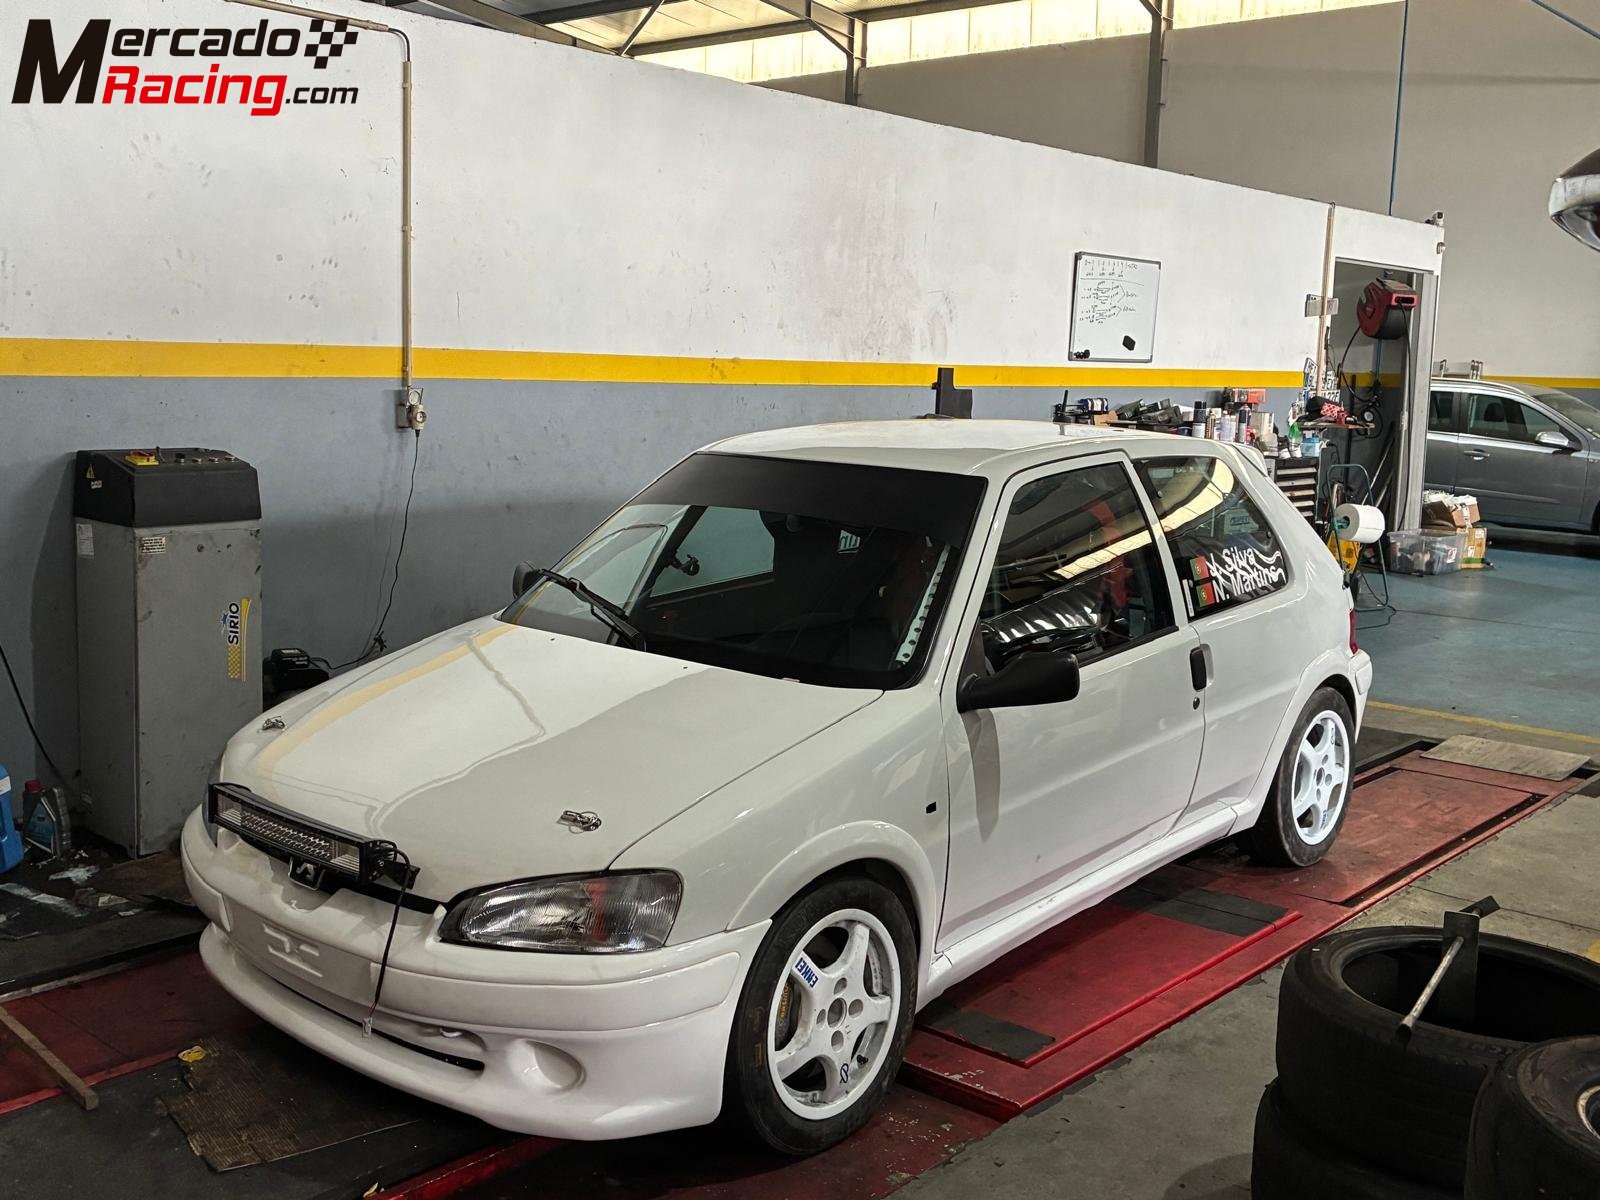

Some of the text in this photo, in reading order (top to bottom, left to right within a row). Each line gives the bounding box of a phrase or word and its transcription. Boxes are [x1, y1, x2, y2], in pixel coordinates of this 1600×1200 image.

[1222, 546, 1257, 572] Silva
[1212, 579, 1230, 603] N.
[1231, 565, 1287, 597] Martins
[227, 602, 240, 645] SIRIO
[794, 957, 819, 988] ENKEI
